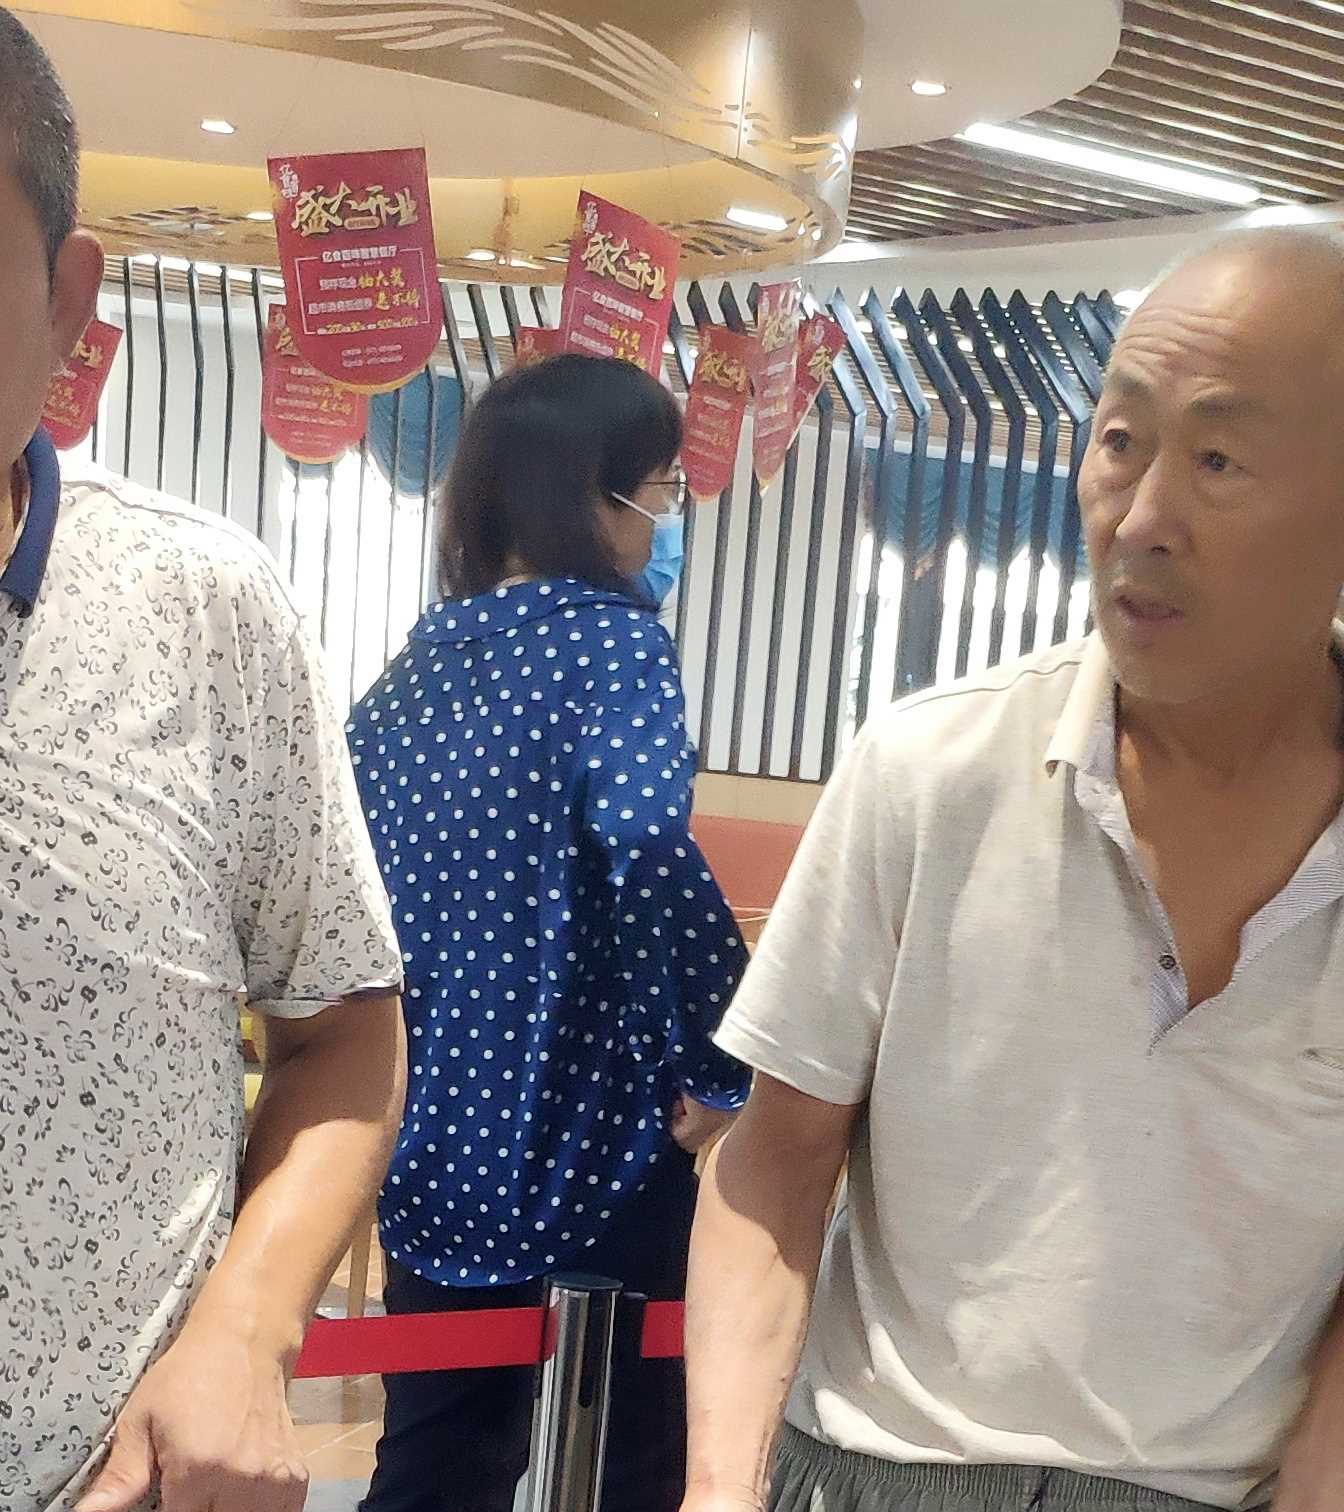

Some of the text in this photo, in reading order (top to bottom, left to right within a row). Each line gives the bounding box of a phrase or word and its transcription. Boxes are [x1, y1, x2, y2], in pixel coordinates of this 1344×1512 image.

[291, 181, 419, 237] 盛大开业
[580, 231, 667, 301] 盛大开业
